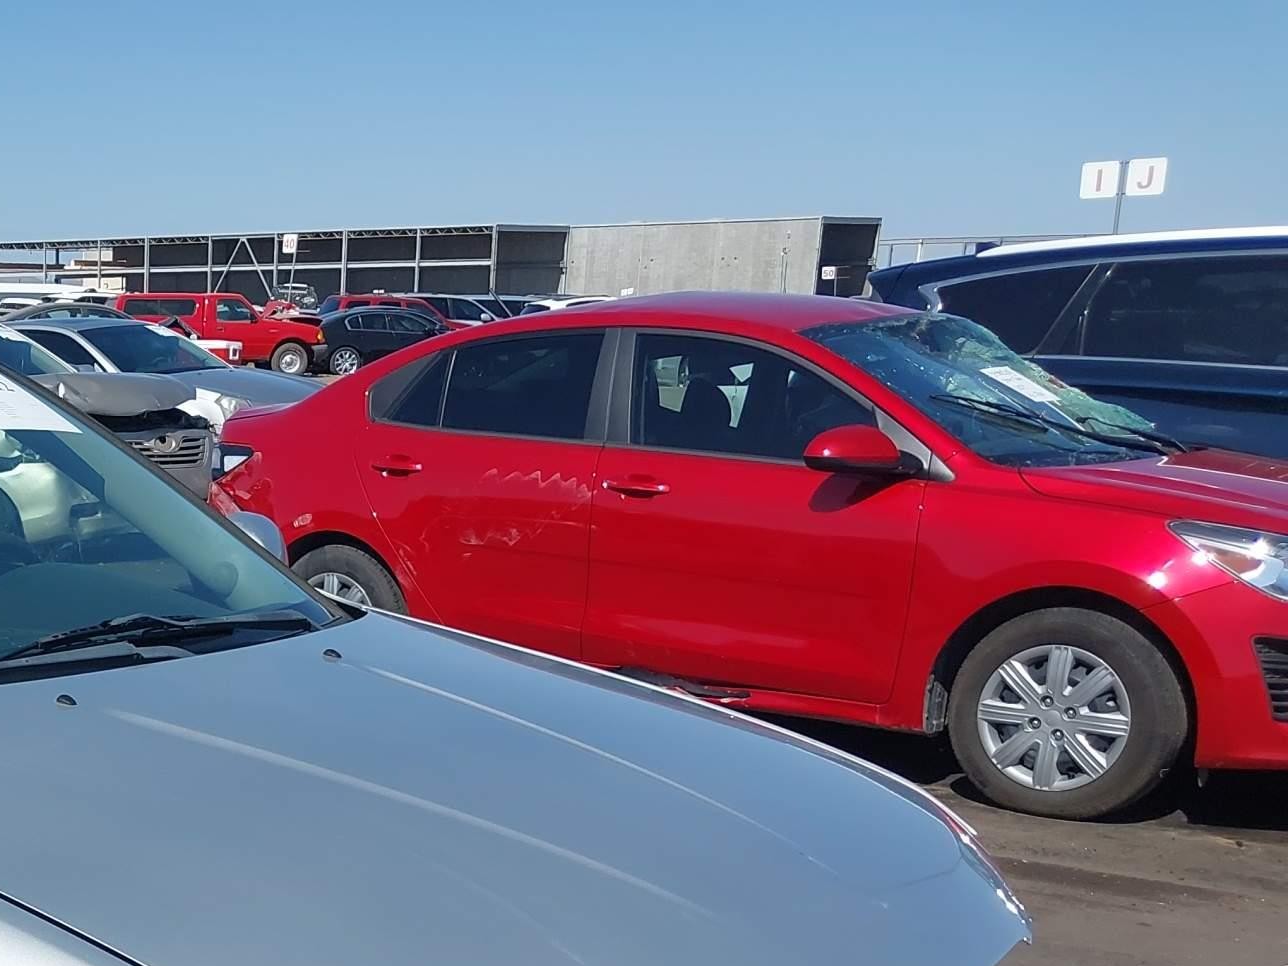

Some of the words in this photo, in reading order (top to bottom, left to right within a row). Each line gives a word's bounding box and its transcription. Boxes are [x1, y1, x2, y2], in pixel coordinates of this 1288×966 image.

[1137, 165, 1154, 189] J
[284, 238, 294, 249] 40
[823, 269, 834, 278] 50
